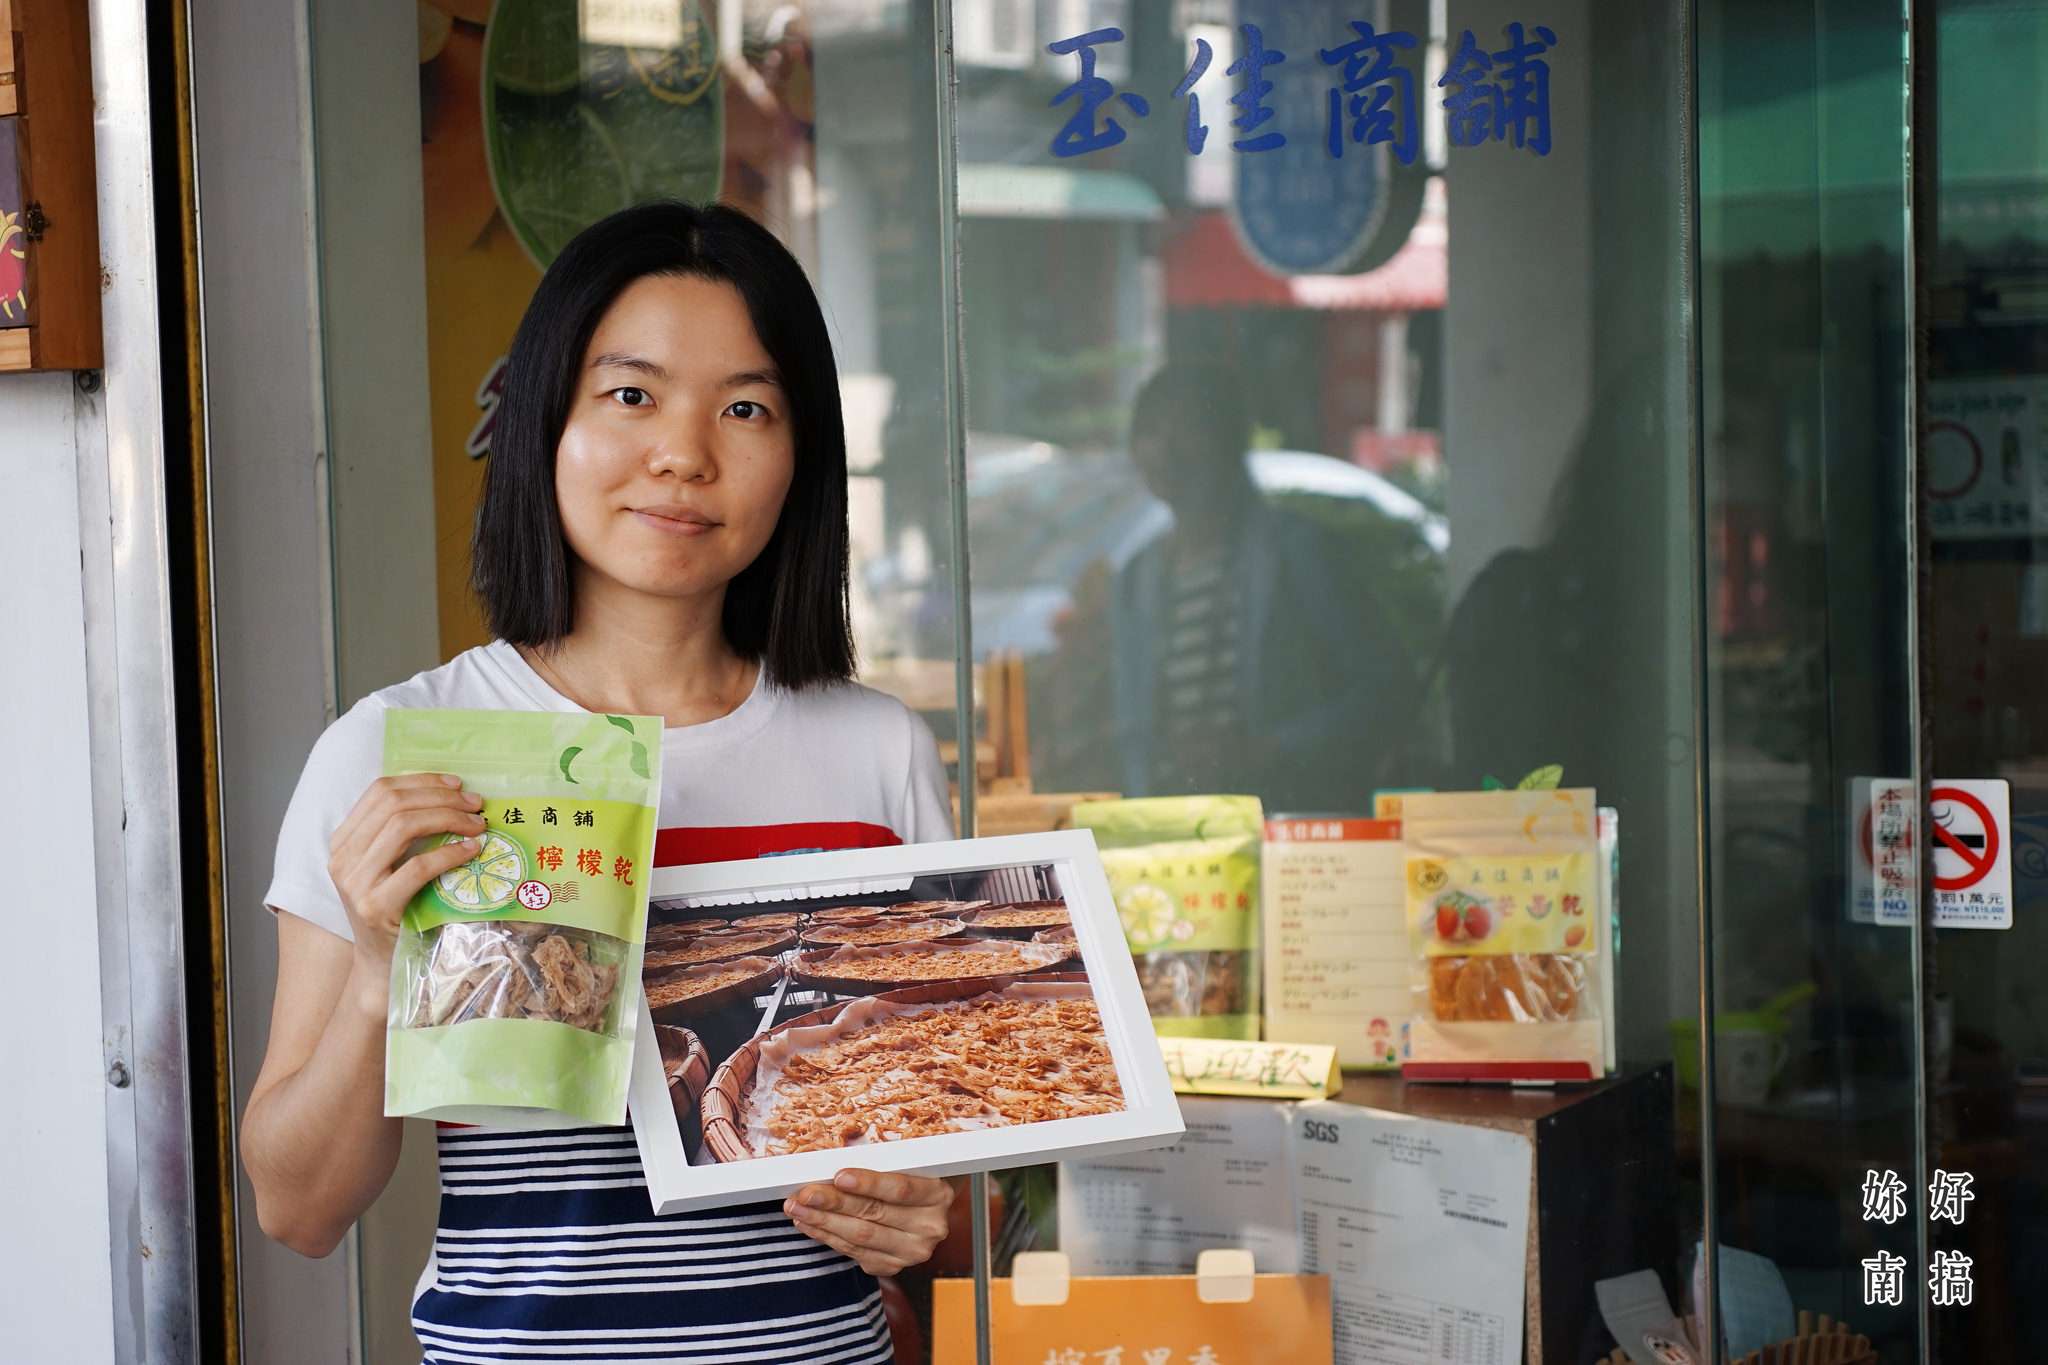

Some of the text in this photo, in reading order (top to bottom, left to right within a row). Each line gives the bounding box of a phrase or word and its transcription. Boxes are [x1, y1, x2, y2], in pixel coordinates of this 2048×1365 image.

[1047, 20, 1557, 166] 玉佳商舖
[477, 806, 594, 828] 佳商舖
[536, 845, 634, 886] 檸檬乾
[1303, 1120, 1340, 1144] SGS
